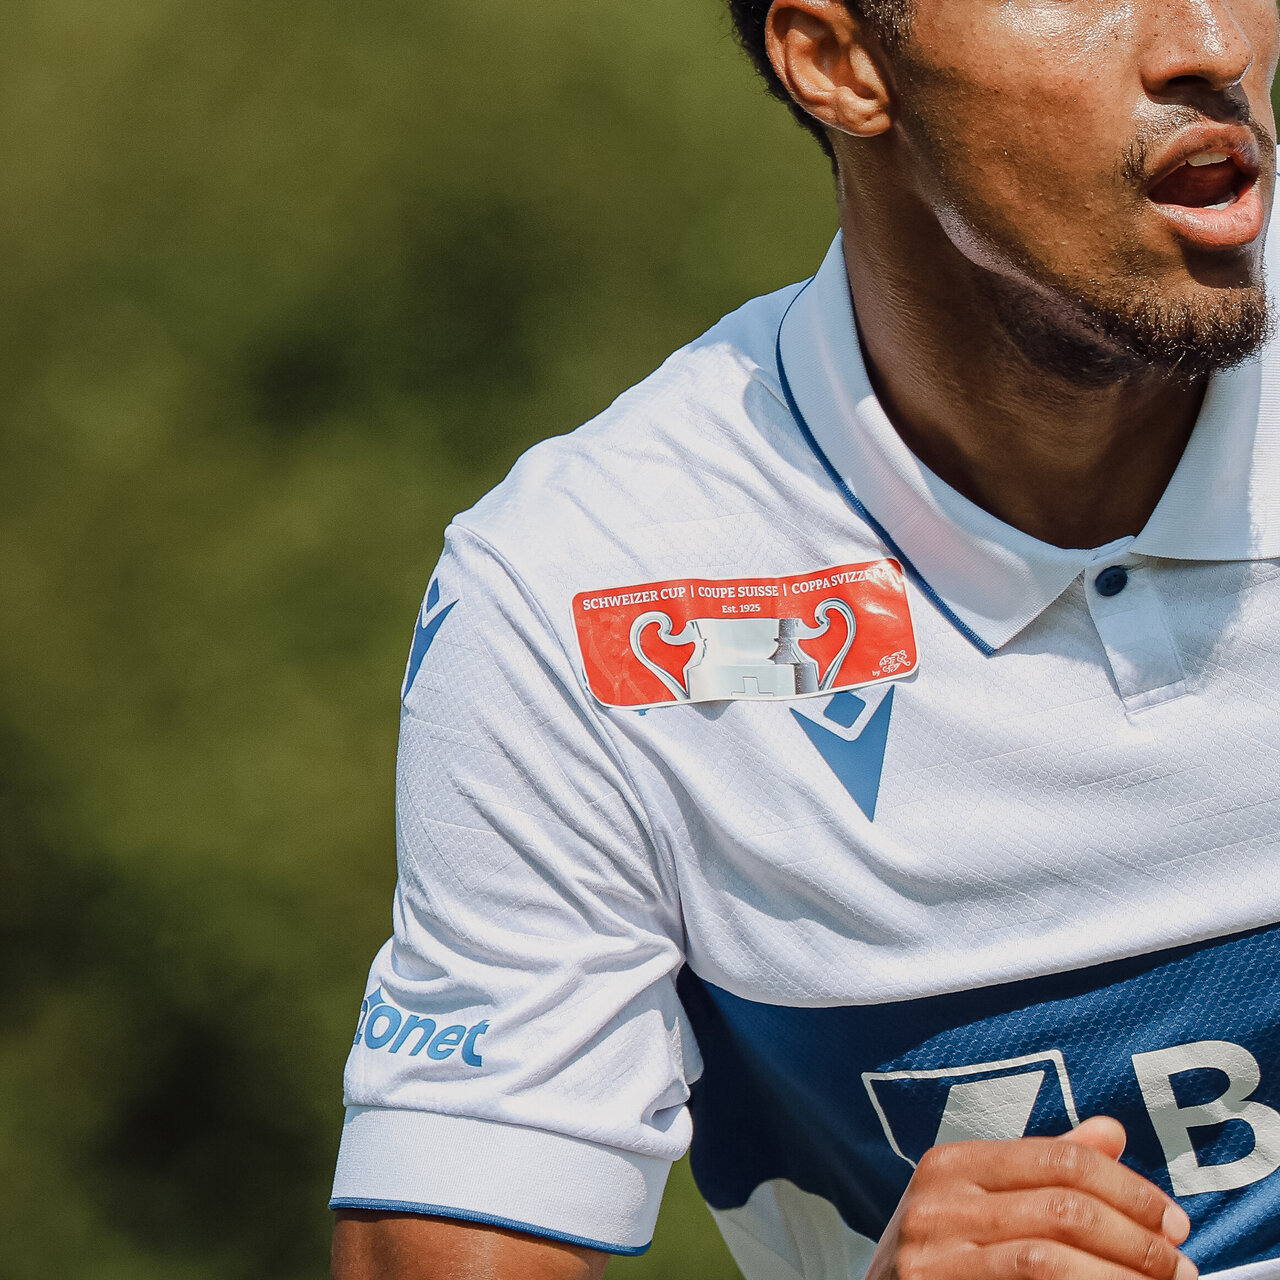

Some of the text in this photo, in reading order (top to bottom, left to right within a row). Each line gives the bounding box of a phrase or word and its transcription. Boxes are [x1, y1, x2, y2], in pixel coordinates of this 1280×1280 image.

[582, 590, 659, 610] SCHWEIZER
[660, 586, 686, 600] CUP
[698, 586, 736, 599] COUPE
[737, 585, 779, 597] SUISSE
[791, 577, 831, 595] COPPA
[721, 603, 761, 613] Est. 1925
